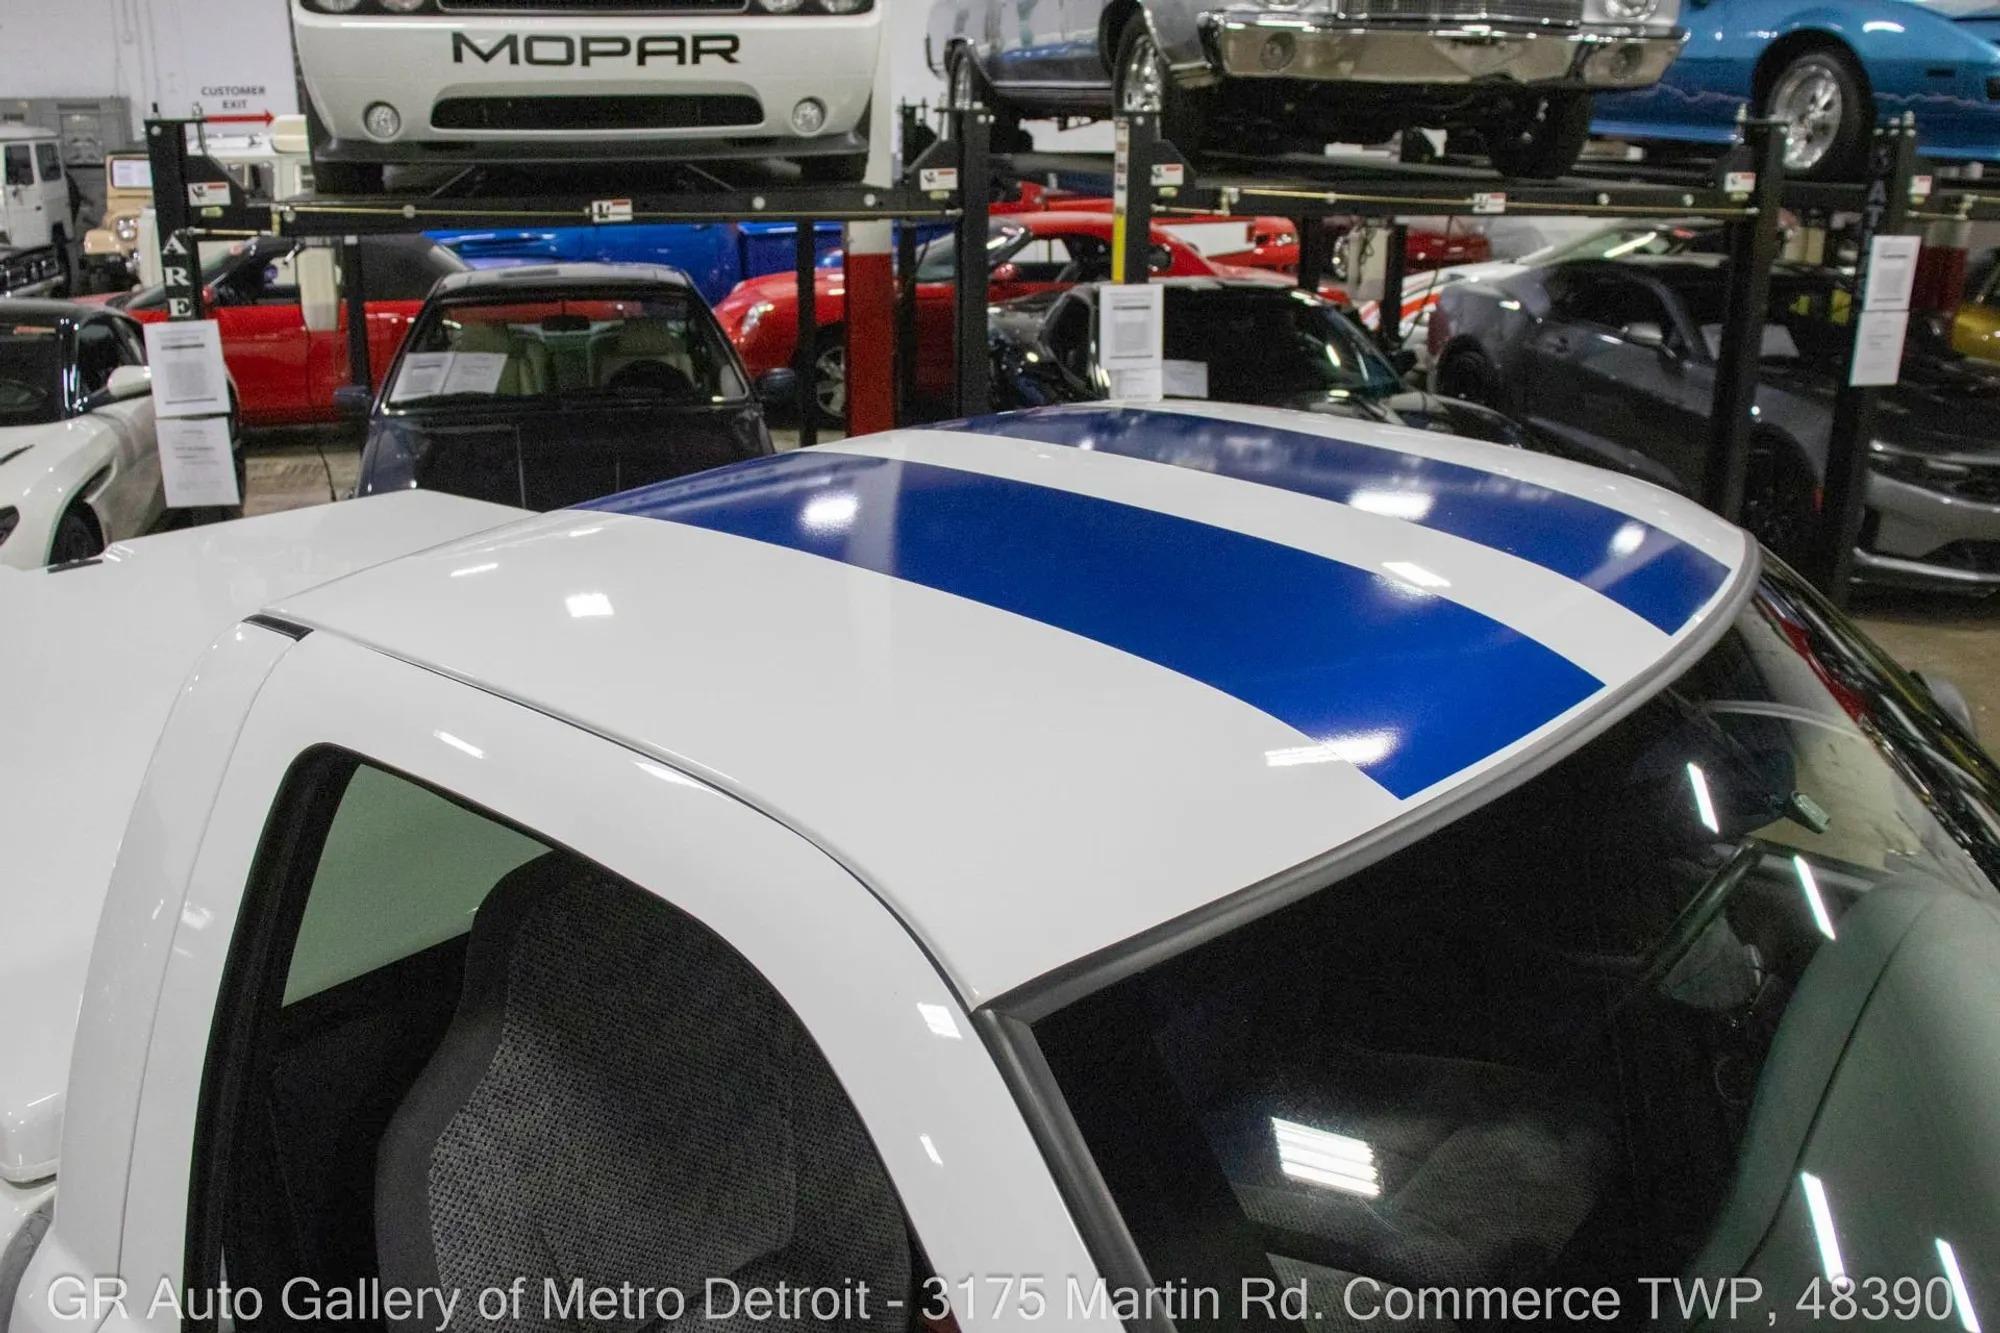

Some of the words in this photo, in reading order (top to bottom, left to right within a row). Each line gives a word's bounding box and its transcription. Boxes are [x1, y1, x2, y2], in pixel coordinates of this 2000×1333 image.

[452, 31, 740, 66] MOPAR
[200, 86, 266, 96] CUSTOMER
[222, 100, 248, 109] EXIT
